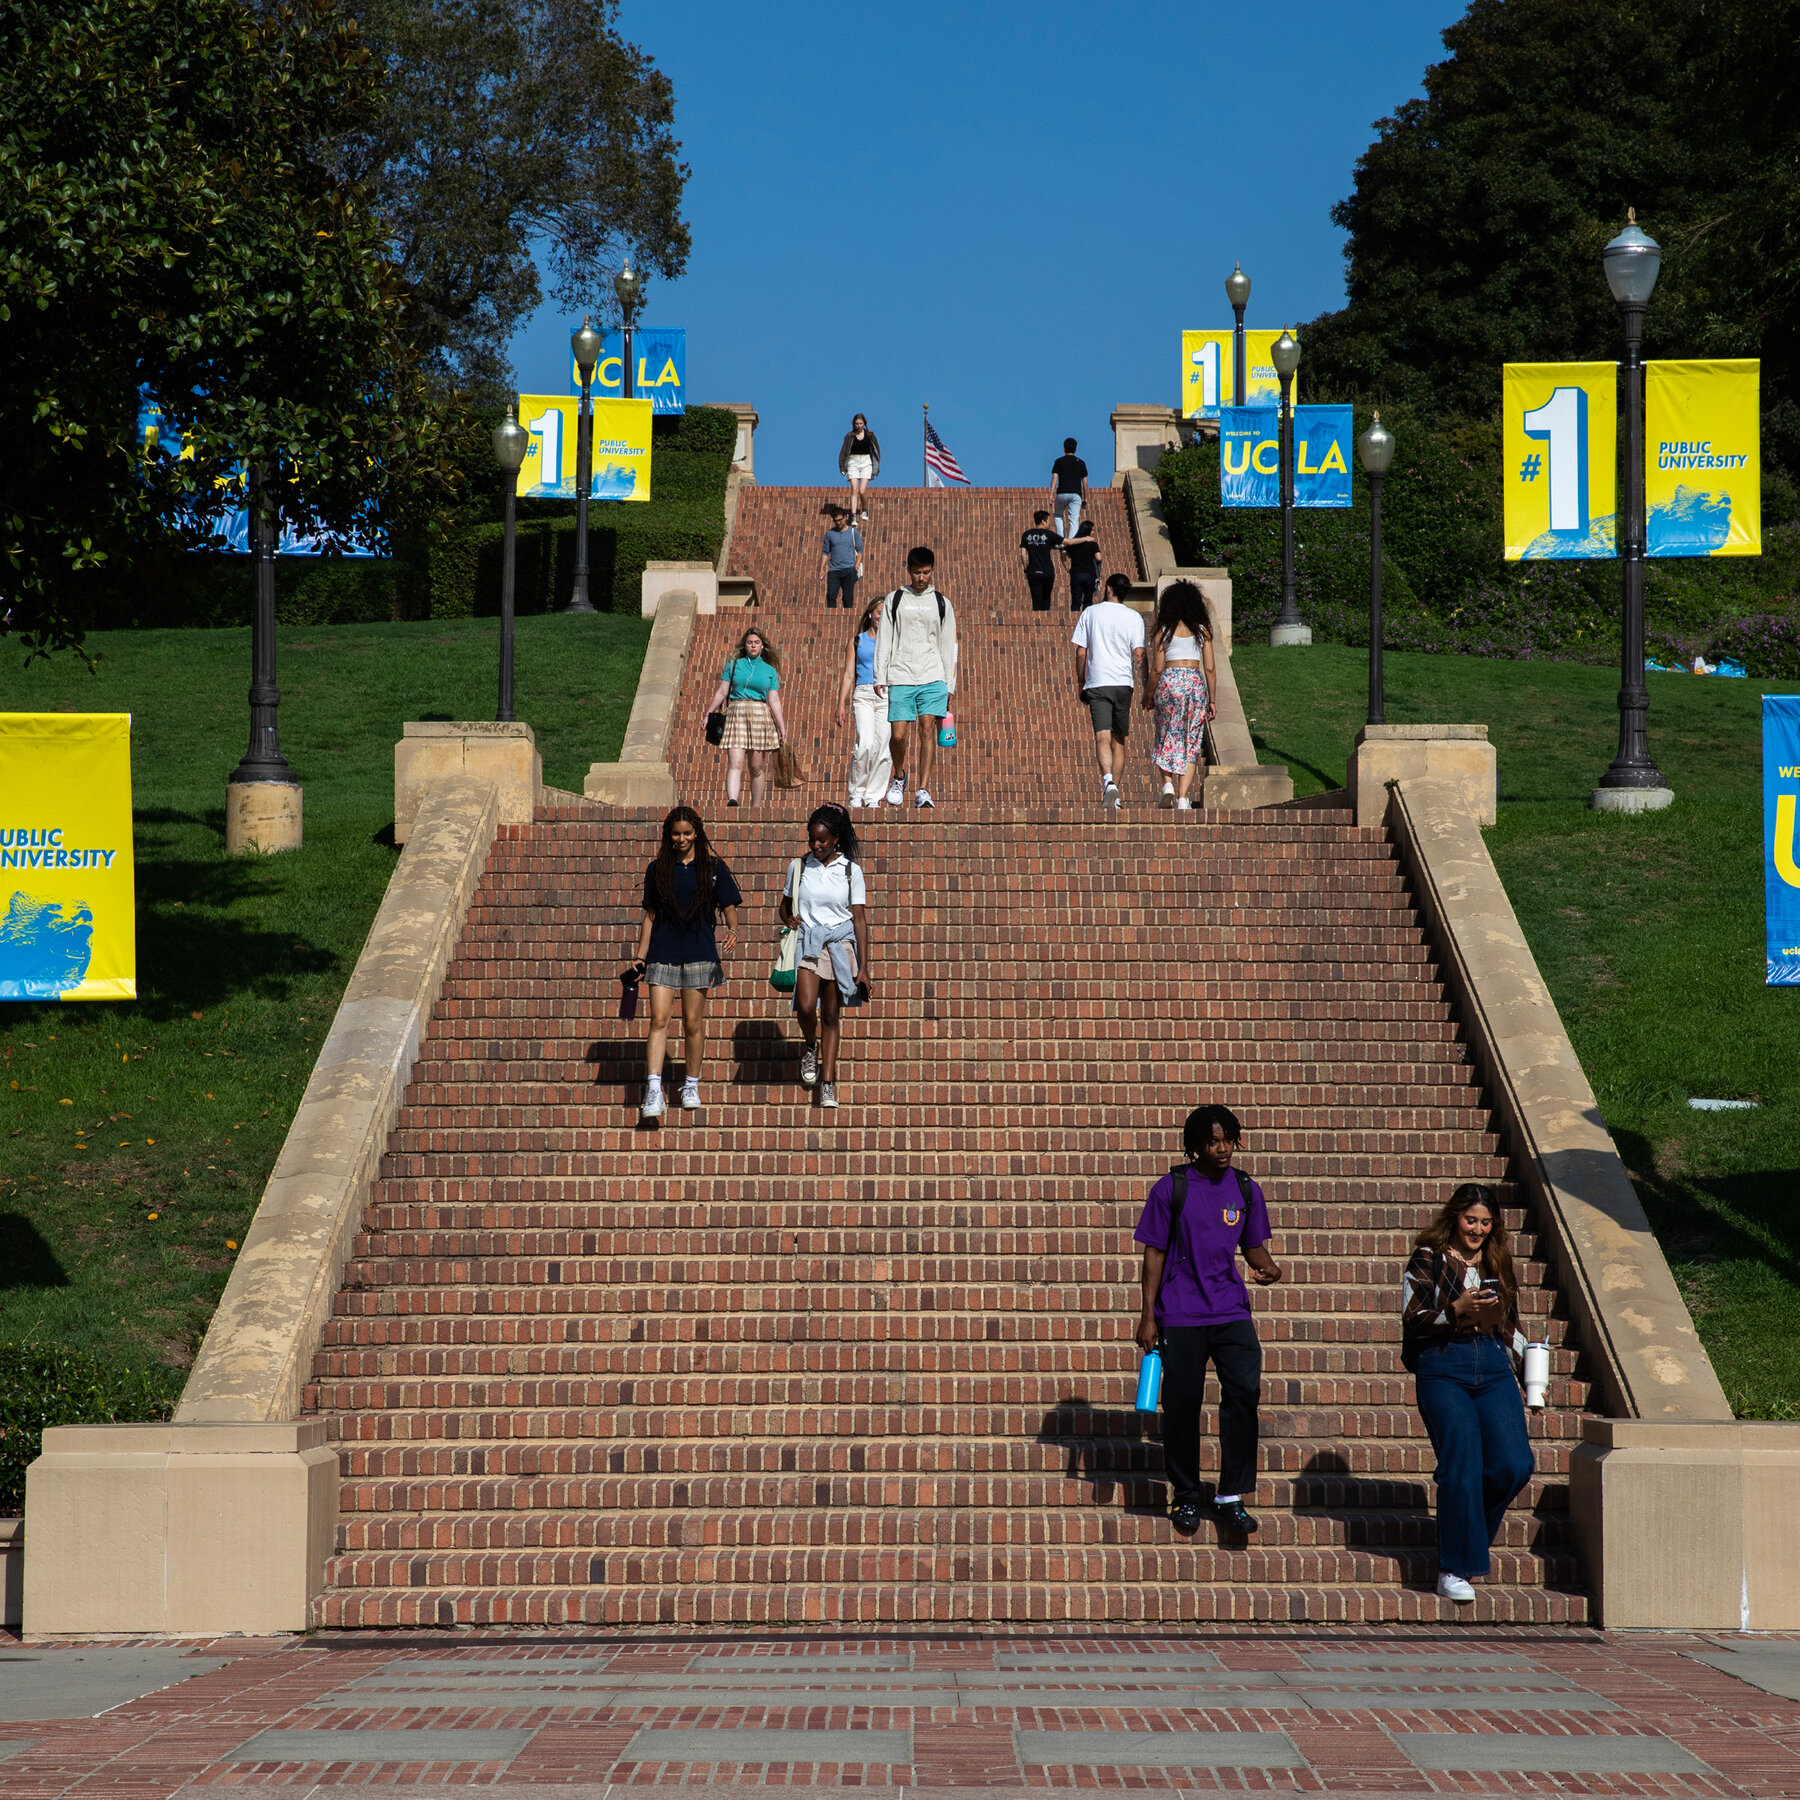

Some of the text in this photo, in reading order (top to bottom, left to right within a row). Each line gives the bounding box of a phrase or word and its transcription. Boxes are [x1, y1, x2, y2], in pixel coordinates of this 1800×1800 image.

[1190, 341, 1220, 407] #1
[1251, 372, 1278, 380] UNIVER
[526, 409, 563, 486] #1
[599, 447, 646, 456] UNIVERSITY
[600, 440, 628, 448] PUBLIC
[1659, 441, 1712, 456] PUBLIC
[1520, 387, 1589, 537] #1
[1658, 455, 1748, 470] UNIVERSITY
[1779, 766, 1800, 778] WE
[0, 829, 64, 849] UBLIC
[0, 849, 117, 869] NIVERSITY
